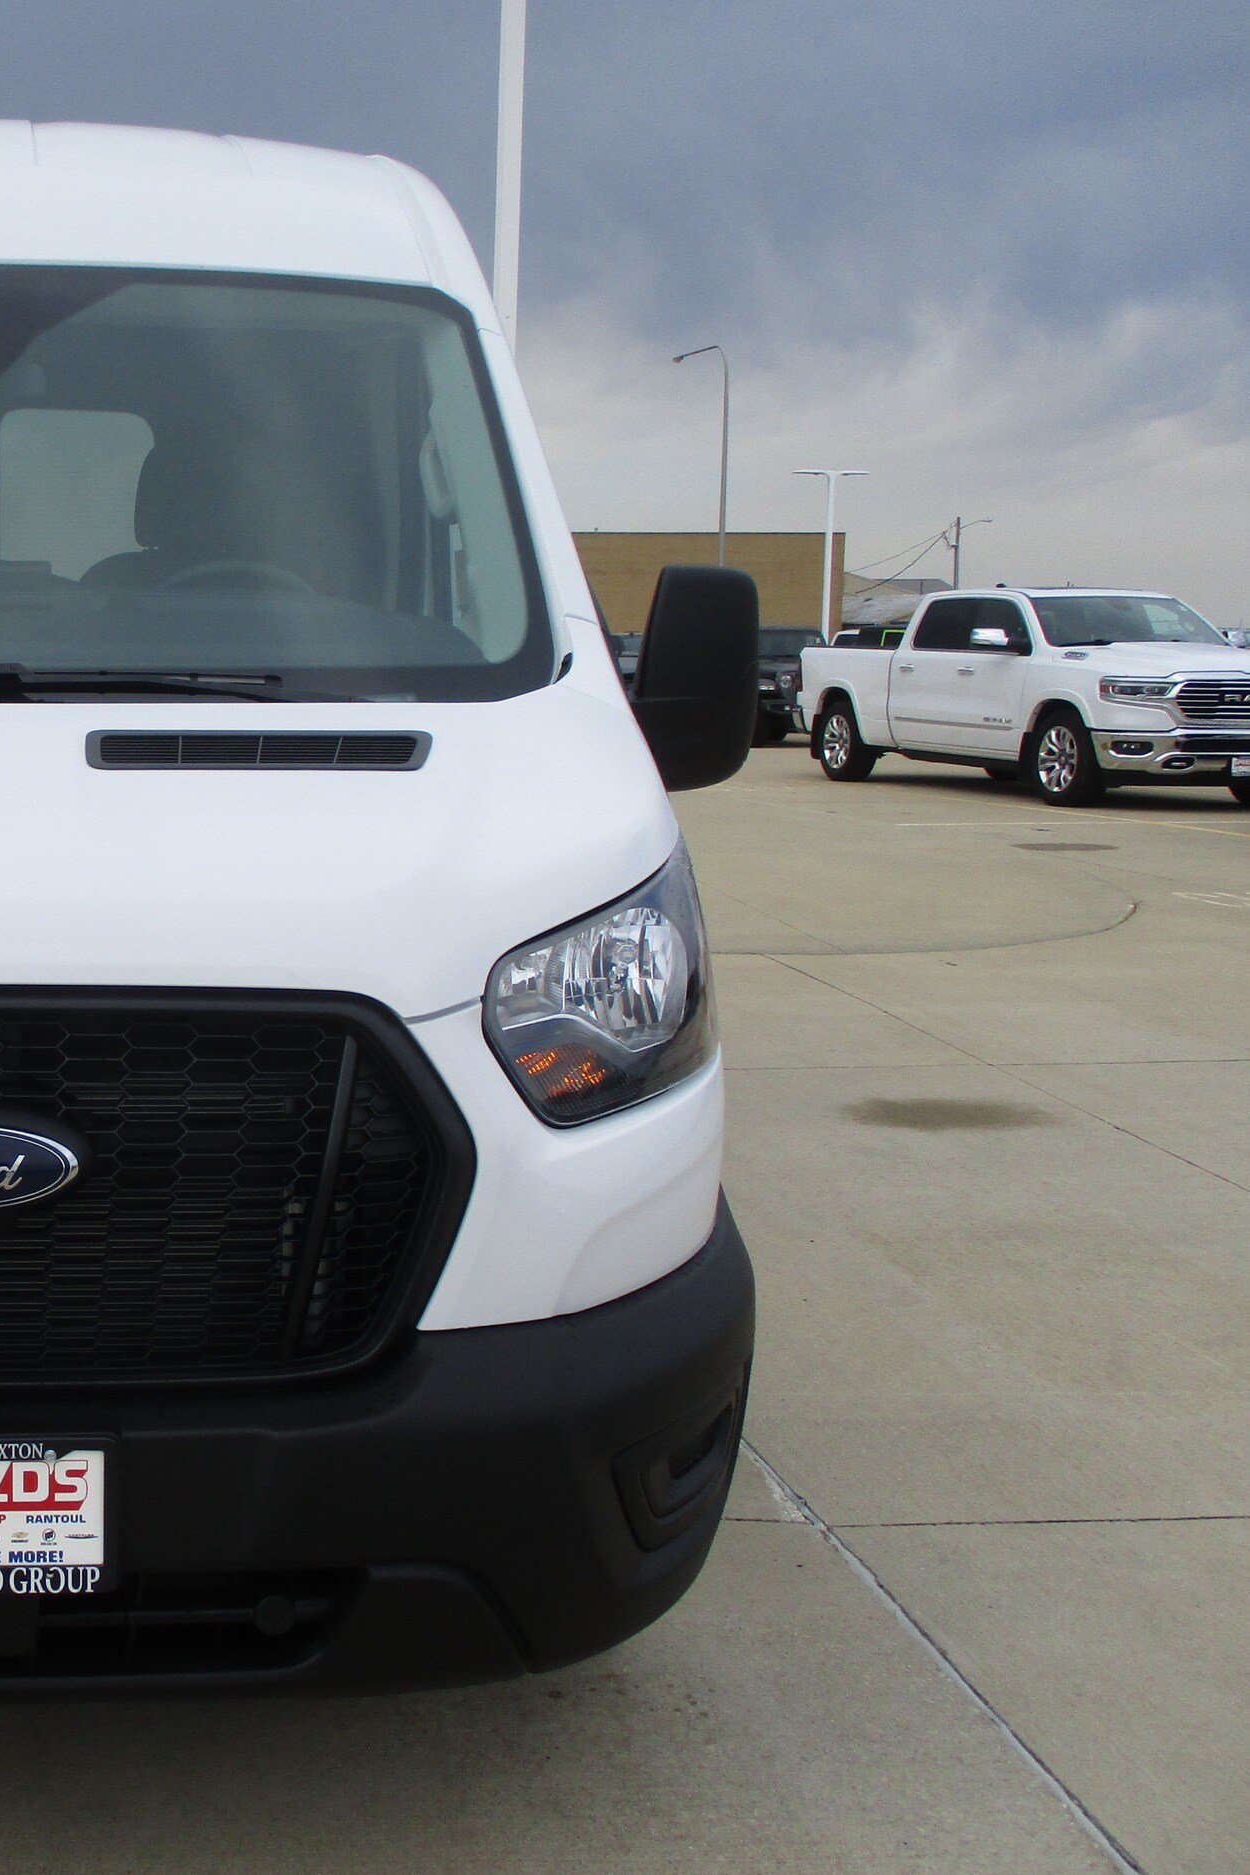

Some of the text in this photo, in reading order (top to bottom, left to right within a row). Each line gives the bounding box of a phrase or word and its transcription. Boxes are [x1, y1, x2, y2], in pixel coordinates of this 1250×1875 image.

[25, 1514, 86, 1524] RANTOUL
[8, 1550, 64, 1564] MORE!
[9, 1566, 100, 1594] GROUP
